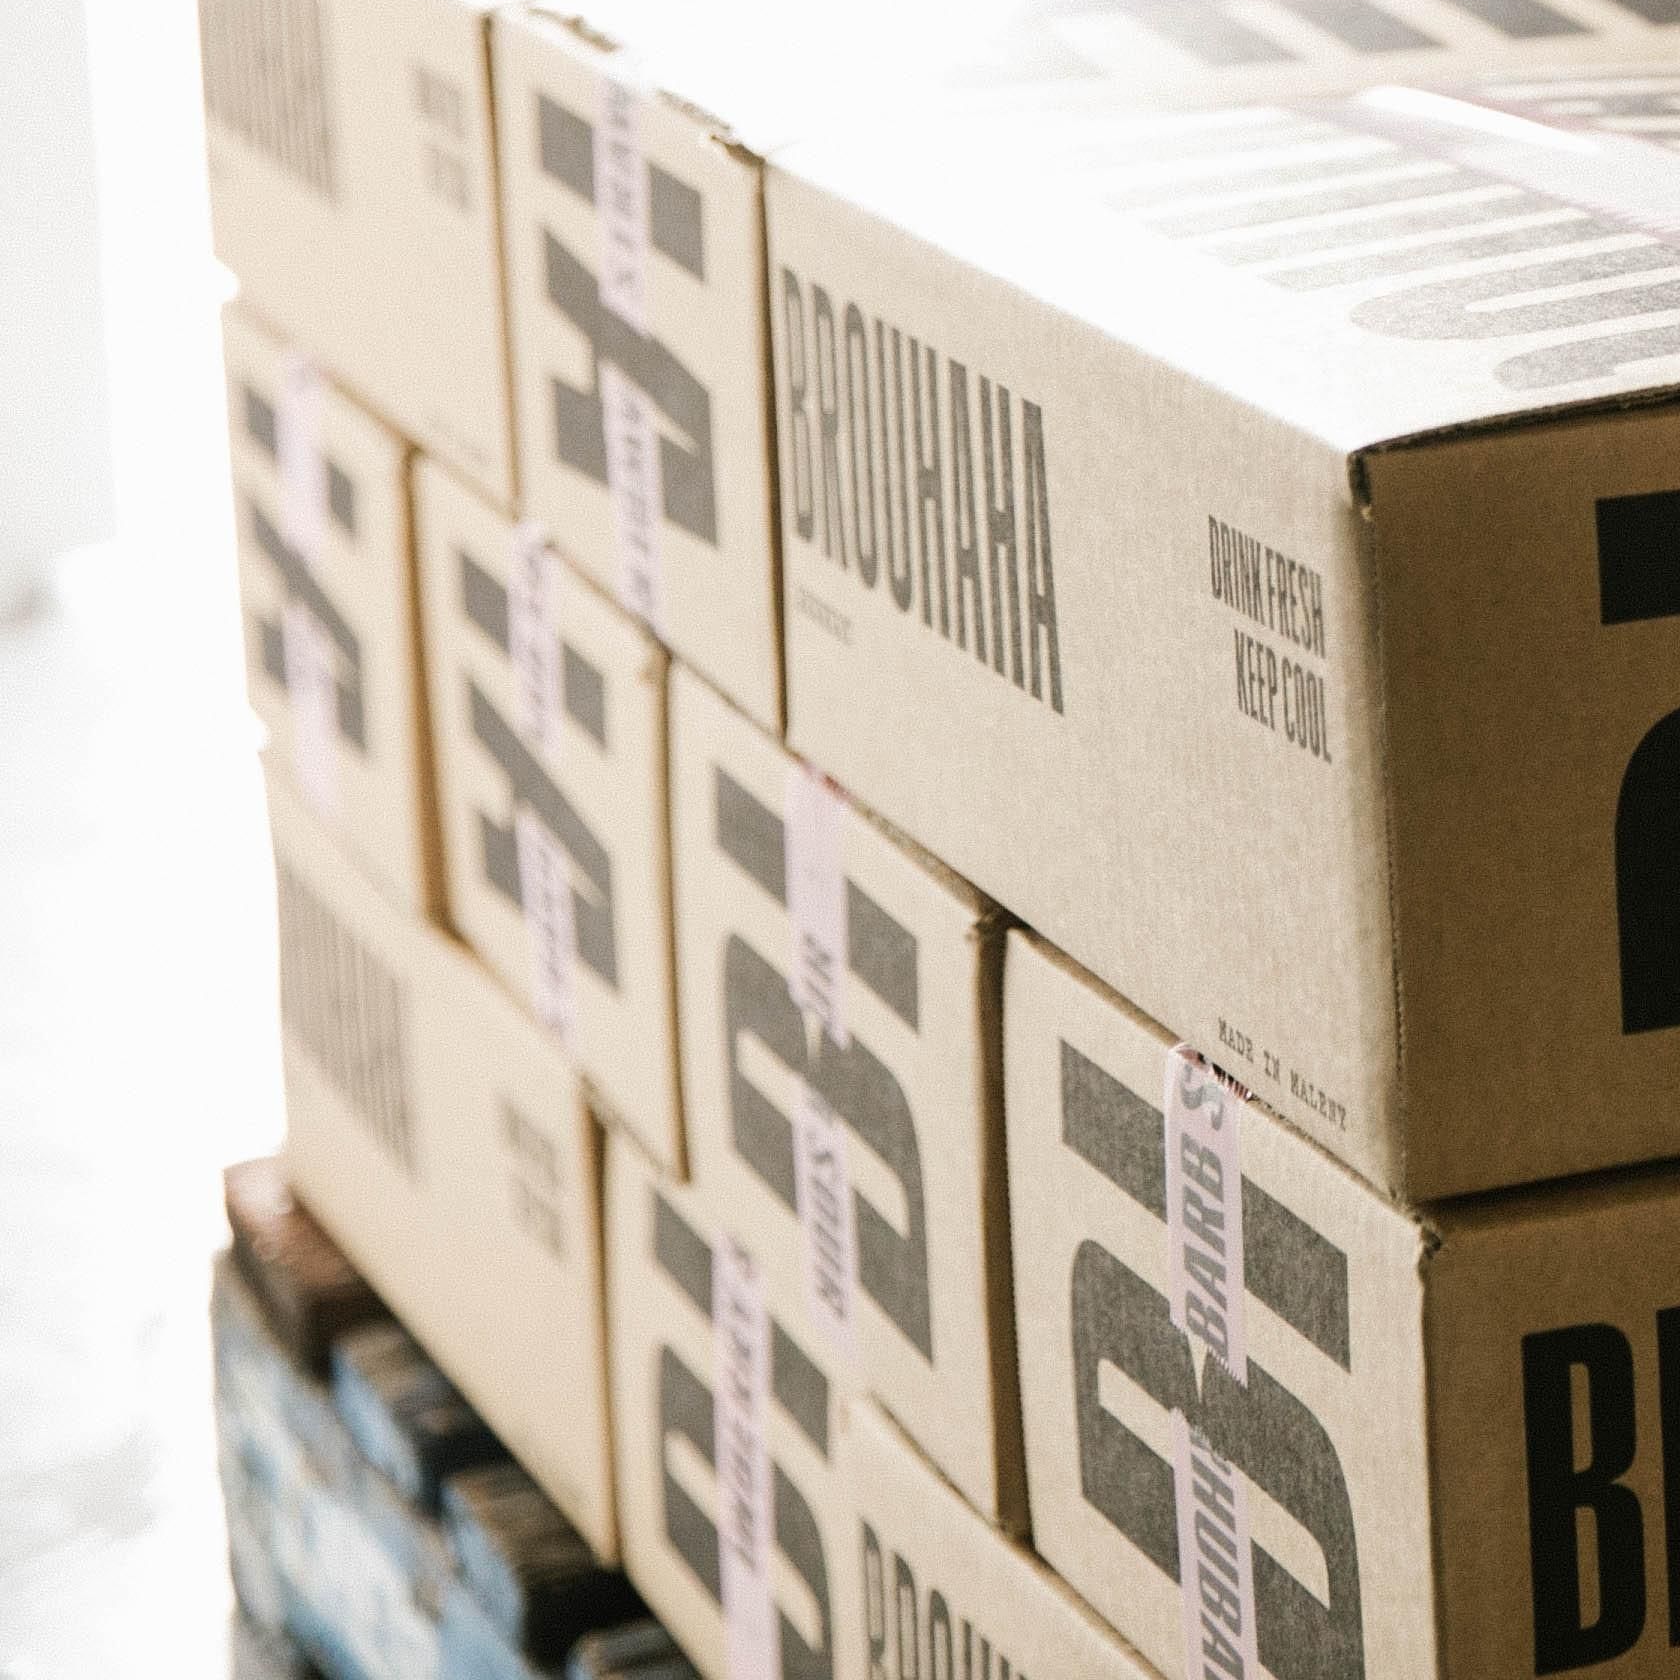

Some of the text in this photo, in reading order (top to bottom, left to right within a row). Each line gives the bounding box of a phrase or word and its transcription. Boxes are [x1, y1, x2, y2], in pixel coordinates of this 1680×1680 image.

[781, 264, 1064, 715] BROUHAHA
[1206, 512, 1328, 660] DRINK FRESH
[1232, 627, 1333, 764] KEEP COOL
[1217, 1016, 1347, 1132] MADE IN MALENY
